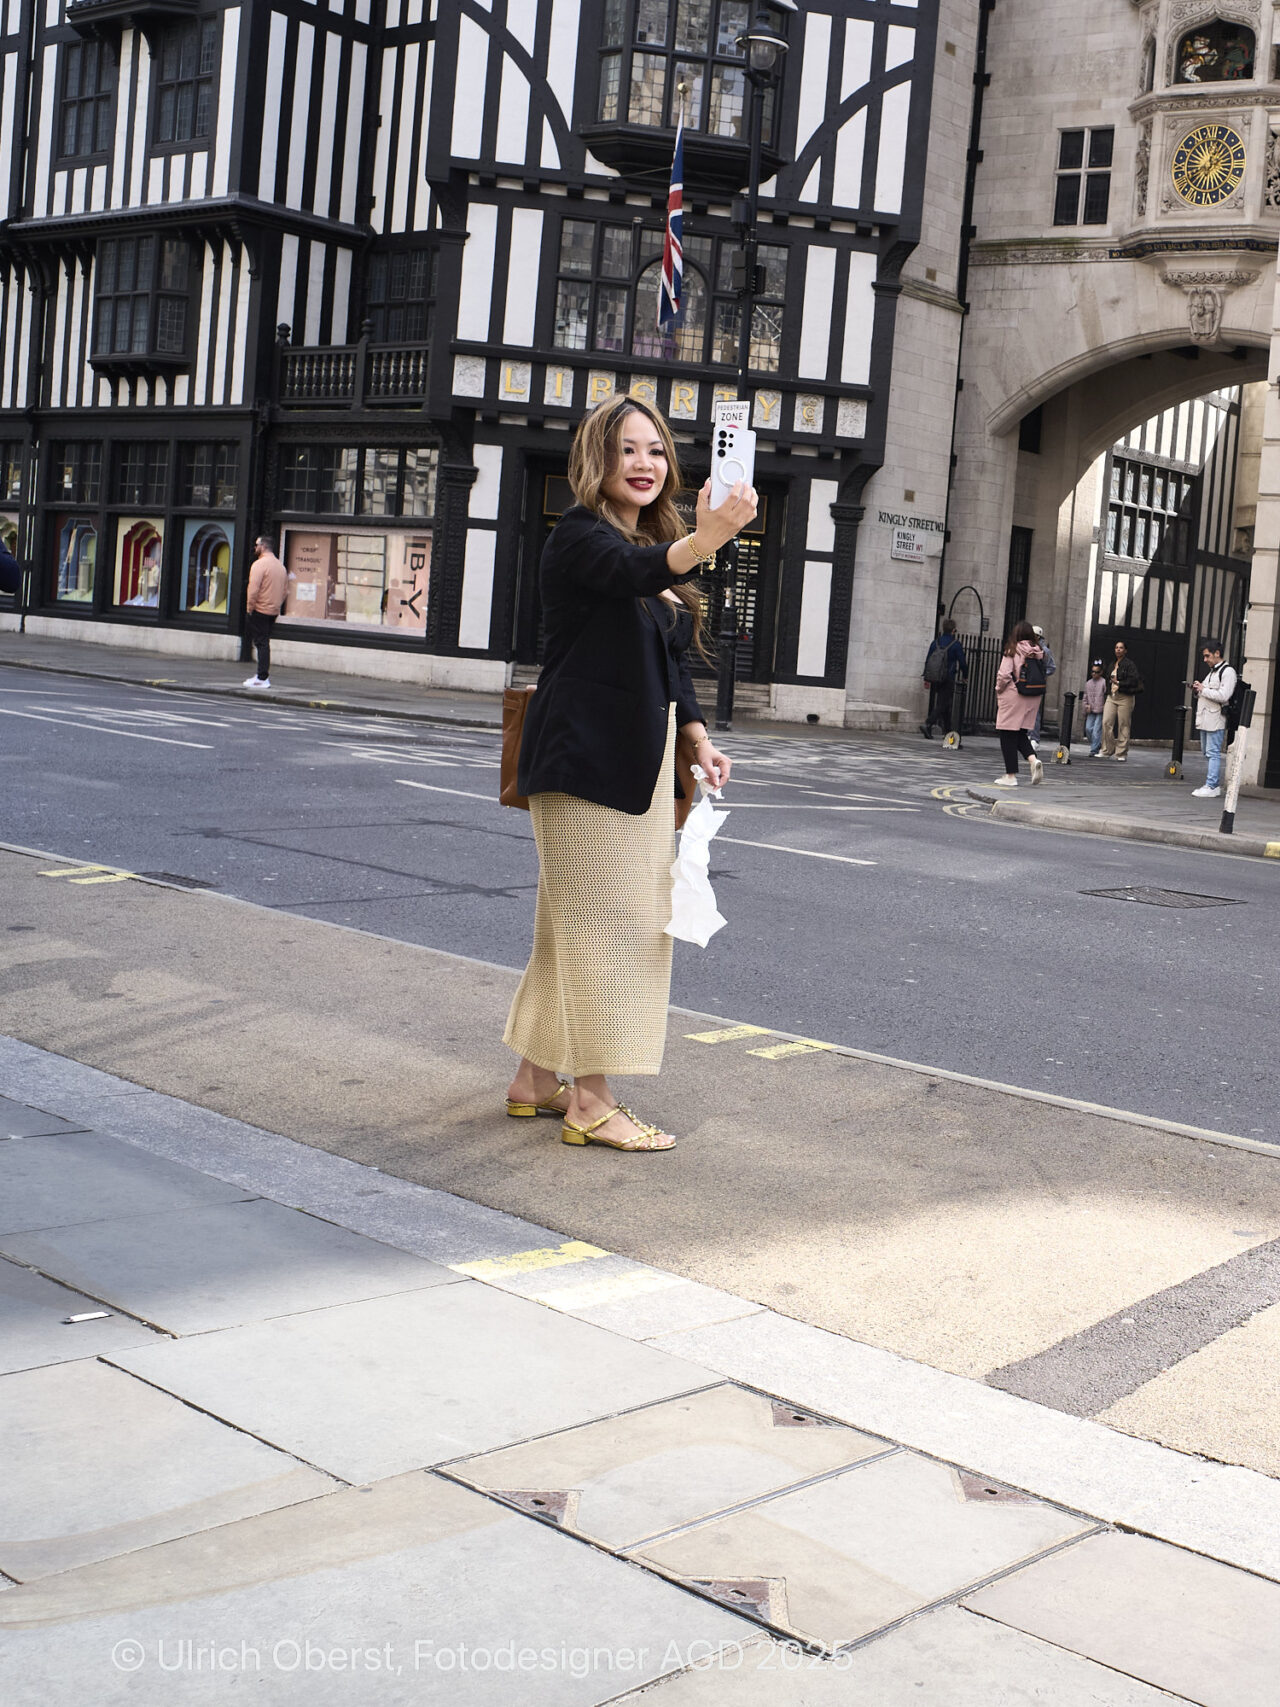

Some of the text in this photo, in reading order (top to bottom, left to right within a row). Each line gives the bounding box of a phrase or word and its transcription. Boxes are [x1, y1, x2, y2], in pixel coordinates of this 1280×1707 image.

[721, 412, 743, 421] ZONE
[879, 511, 907, 526] KINGLY
[908, 517, 934, 532] STREET
[897, 531, 916, 542] KINGLY
[896, 541, 915, 551] STREET
